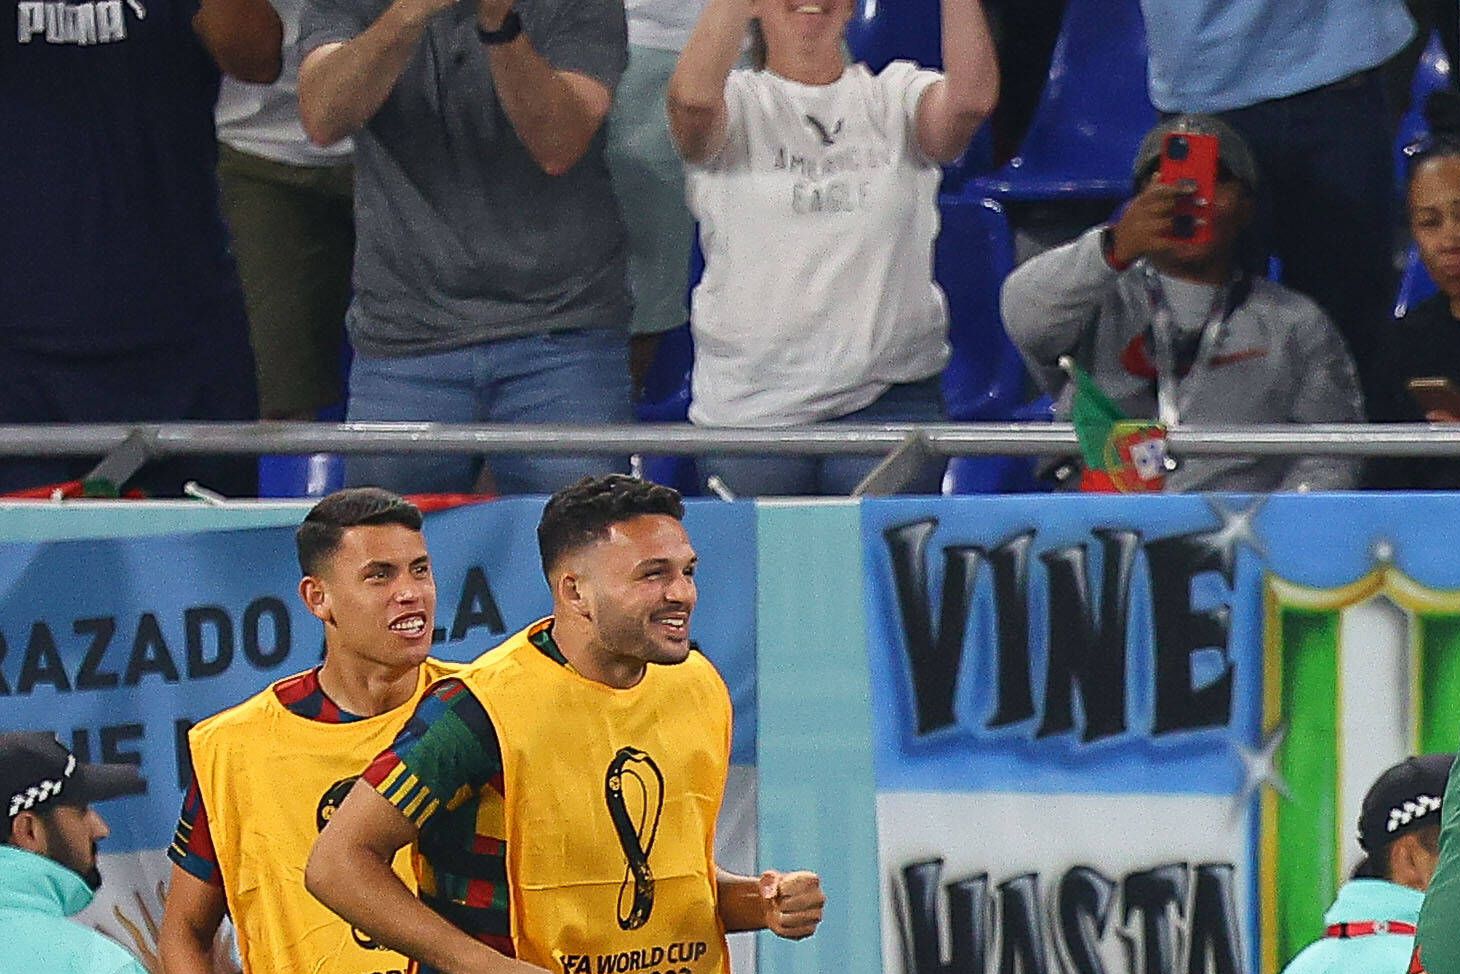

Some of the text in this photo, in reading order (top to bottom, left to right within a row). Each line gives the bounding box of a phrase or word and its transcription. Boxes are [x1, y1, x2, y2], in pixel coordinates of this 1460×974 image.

[17, 0, 127, 46] PUMA
[884, 516, 1236, 741] VINE
[597, 946, 664, 974] WORLD
[667, 941, 706, 964] CUP
